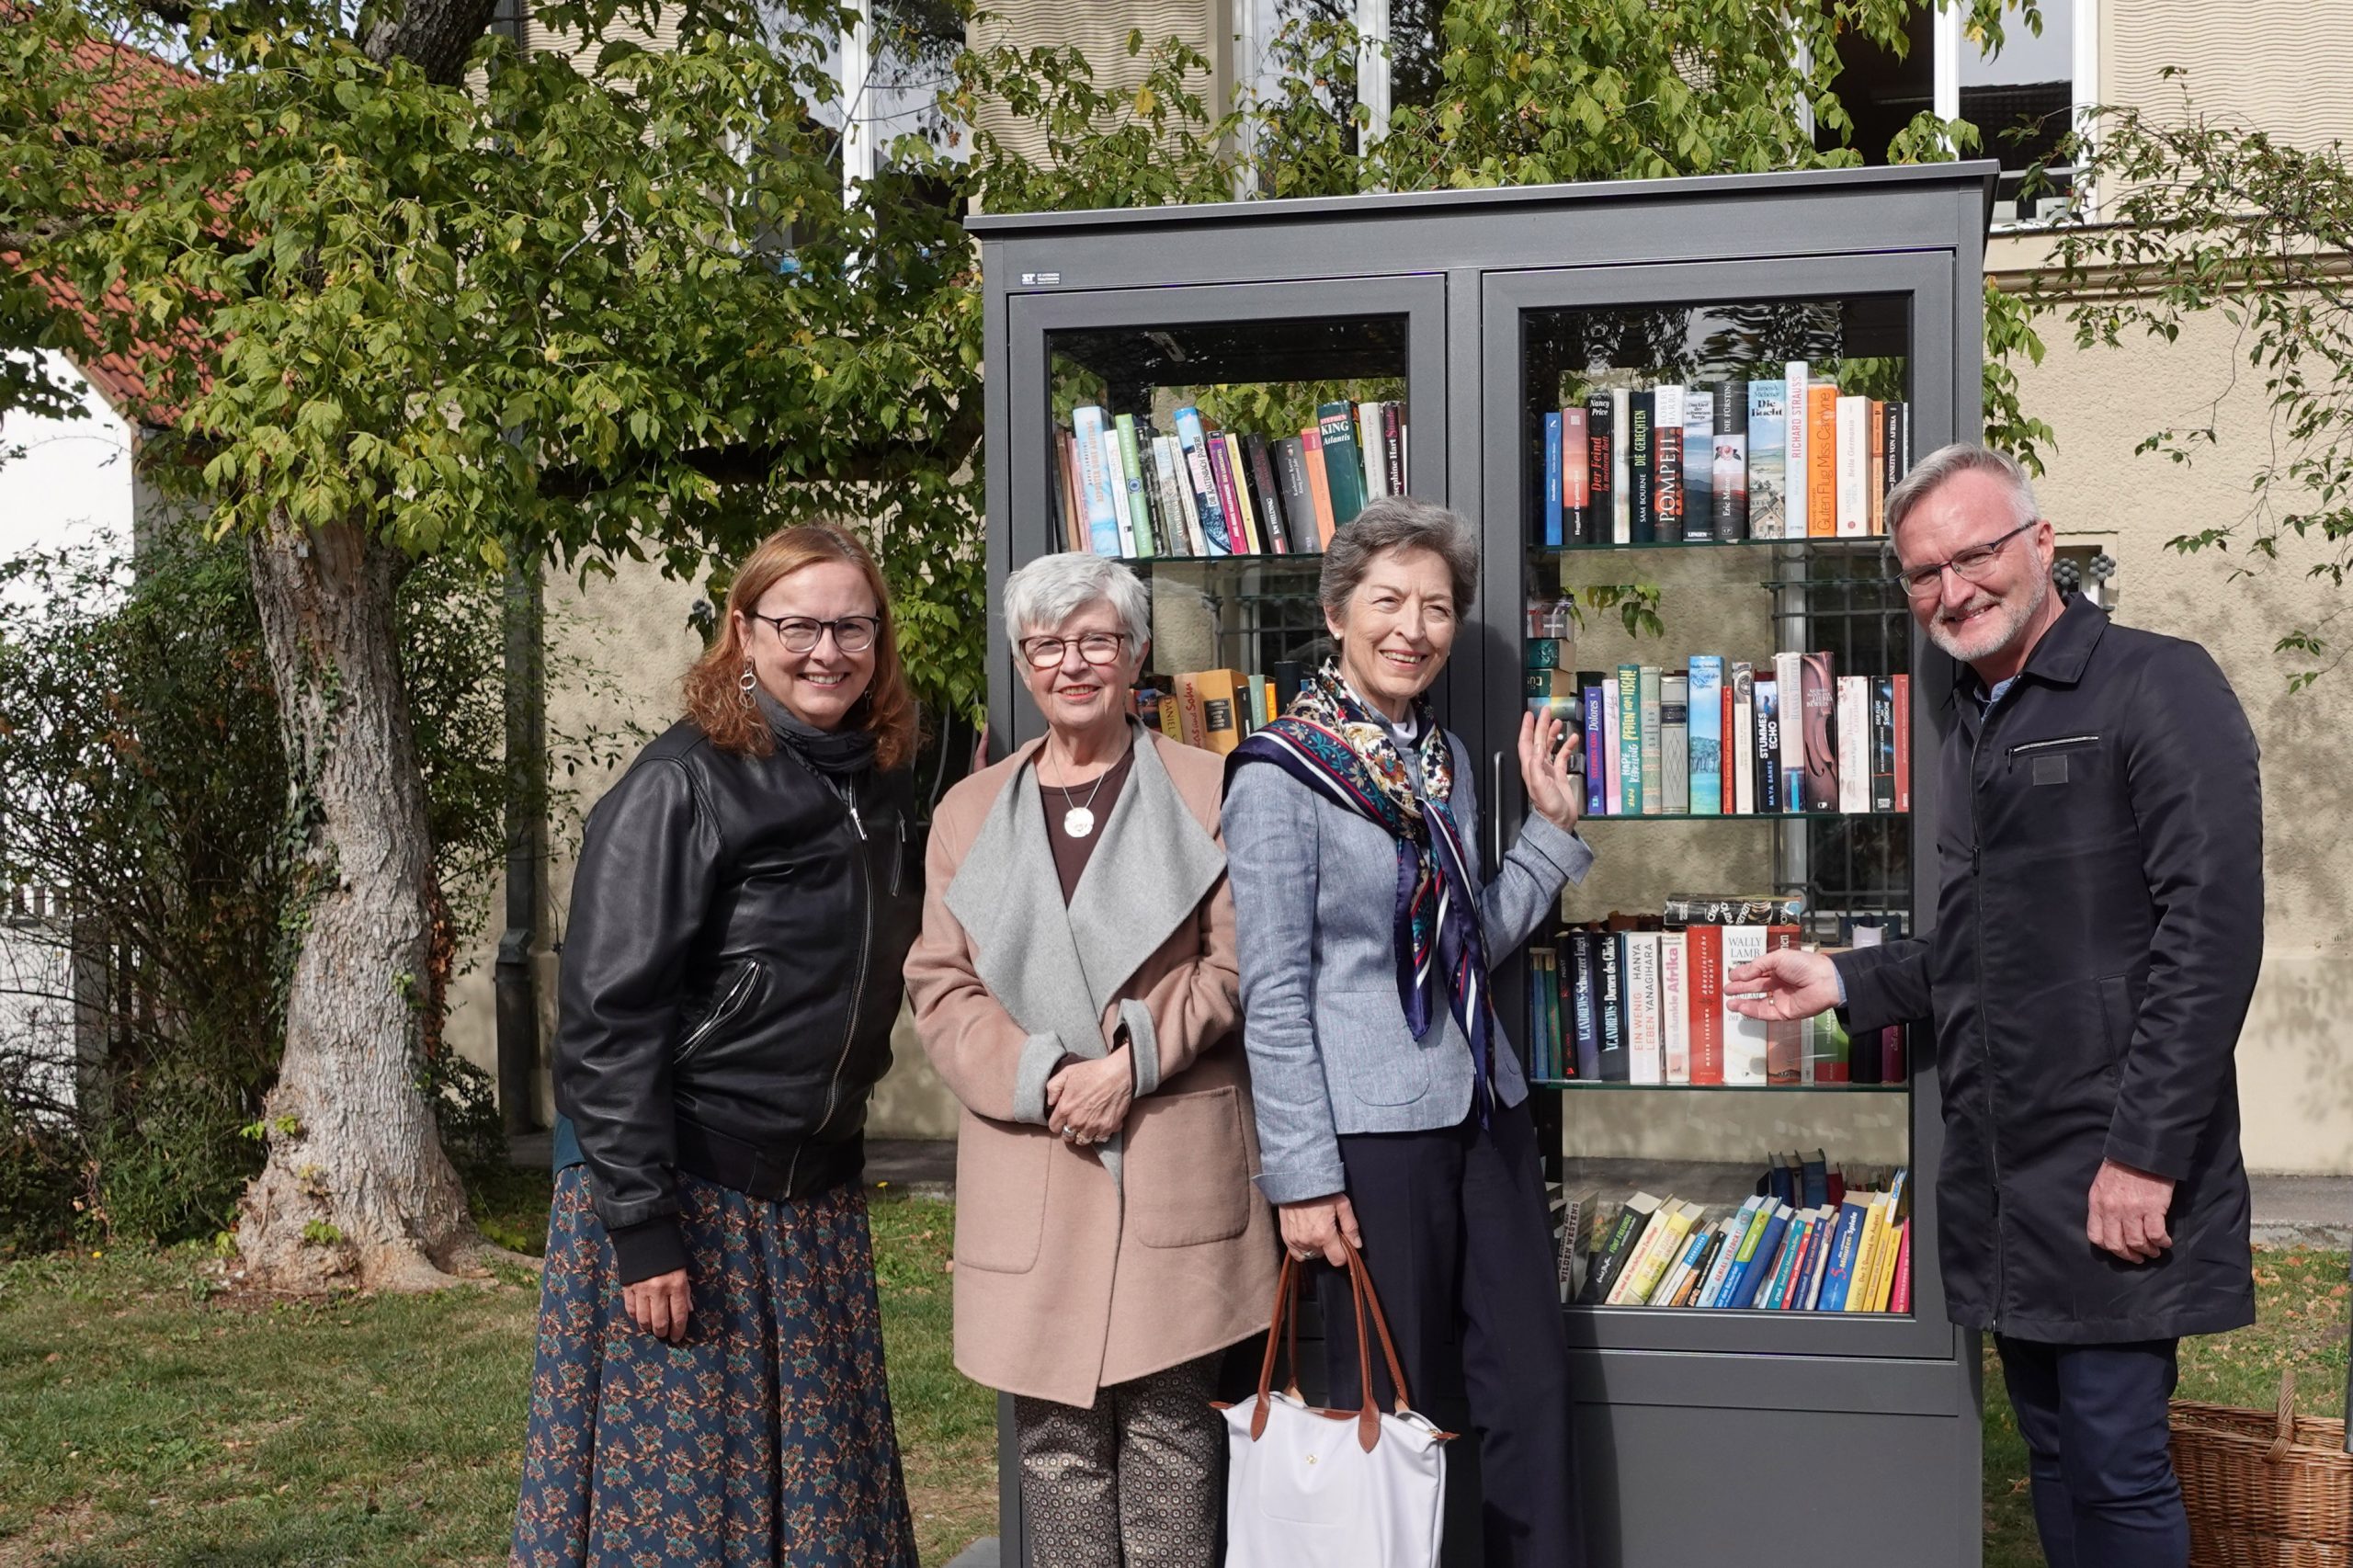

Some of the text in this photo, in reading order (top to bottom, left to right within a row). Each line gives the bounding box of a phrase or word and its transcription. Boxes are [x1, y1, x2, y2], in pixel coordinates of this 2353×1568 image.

[1590, 399, 1609, 408] Nancy
[1757, 400, 1776, 408] Die
[1791, 375, 1802, 415] STRAUSS
[1320, 414, 1347, 425] STEPHEN
[1321, 421, 1349, 436] KING
[1324, 434, 1351, 445] Atlantis
[1388, 438, 1396, 459] Hart
[1601, 436, 1609, 450] Bett
[1634, 410, 1646, 466] DIE GERECHTEN
[1792, 418, 1802, 458] RICHARD
[1192, 435, 1217, 505] DIE KALTENBACH PAPIERE
[1590, 437, 1602, 492] Der Feind
[1601, 452, 1609, 482] meinem
[1817, 392, 1833, 530] Guten Flug Miss Carolyne
[1659, 439, 1678, 522] POMPEJI
[1265, 496, 1278, 525] FIELDING
[1722, 502, 1731, 516] Eric
[1184, 682, 1196, 710] Sohn
[1620, 670, 1637, 696] TISCH!
[1787, 661, 1800, 720] HANNAS TÖCHTER
[1164, 697, 1176, 732] DANIEL
[1587, 700, 1598, 731] Dolores
[1622, 712, 1640, 741] PFOTEN
[1758, 712, 1768, 759] STUMMES
[1768, 721, 1778, 749] ECHO
[1621, 753, 1630, 776] HAPE
[1630, 744, 1640, 783] KERKELING
[1574, 937, 1589, 956] Engel
[1602, 937, 1615, 960] Glücks
[1728, 937, 1761, 947] WALLY
[1731, 948, 1759, 958] LAMB
[1575, 958, 1587, 994] Schwarzer
[1603, 962, 1616, 974] des
[1632, 943, 1642, 980] HANYA
[1666, 948, 1678, 993] Afrika
[1604, 974, 1617, 1001] Dornen
[1644, 943, 1654, 1011] YANAGIHARA
[1633, 993, 1643, 1051] EIN WENIG
[1668, 995, 1678, 1031] dunkle
[1646, 1016, 1654, 1051] LEBEN
[1608, 1211, 1632, 1254] FÜNF FREUNDE
[1870, 1213, 1881, 1234] August
[1561, 1201, 1578, 1282] WILDEN WESTENS
[1713, 1260, 1727, 1282] GENIAL
